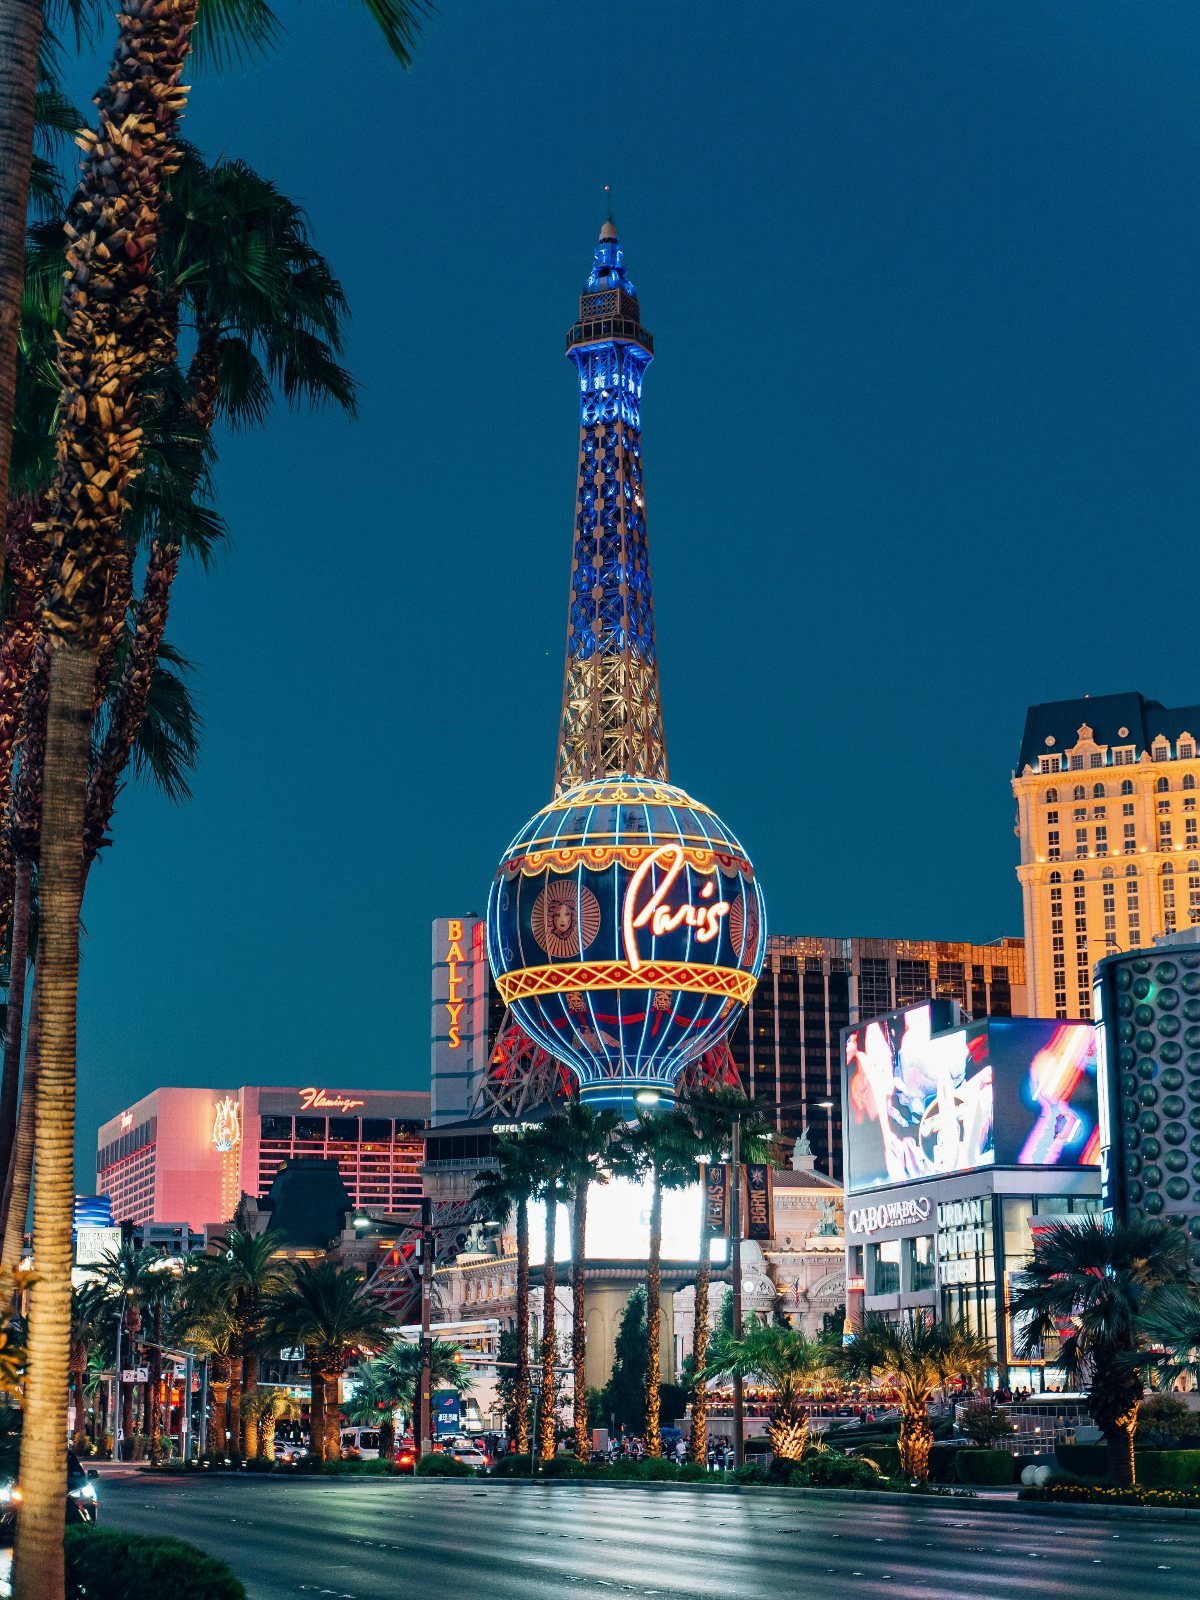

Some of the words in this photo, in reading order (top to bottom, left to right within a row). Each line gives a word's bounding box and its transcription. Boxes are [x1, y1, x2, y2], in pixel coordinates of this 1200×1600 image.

[623, 843, 729, 971] Paris
[445, 920, 464, 1048] BALLYS
[299, 1087, 364, 1113] Flamingo
[492, 1124, 519, 1134] EIFFEL
[706, 1185, 723, 1226] VEGAS
[751, 1190, 766, 1223] BORN
[849, 1205, 888, 1235] CABO
[887, 1197, 929, 1220] WABO
[937, 1200, 982, 1228] URBAN
[889, 1217, 916, 1227] CANTINA
[938, 1229, 984, 1257] OUTFIT
